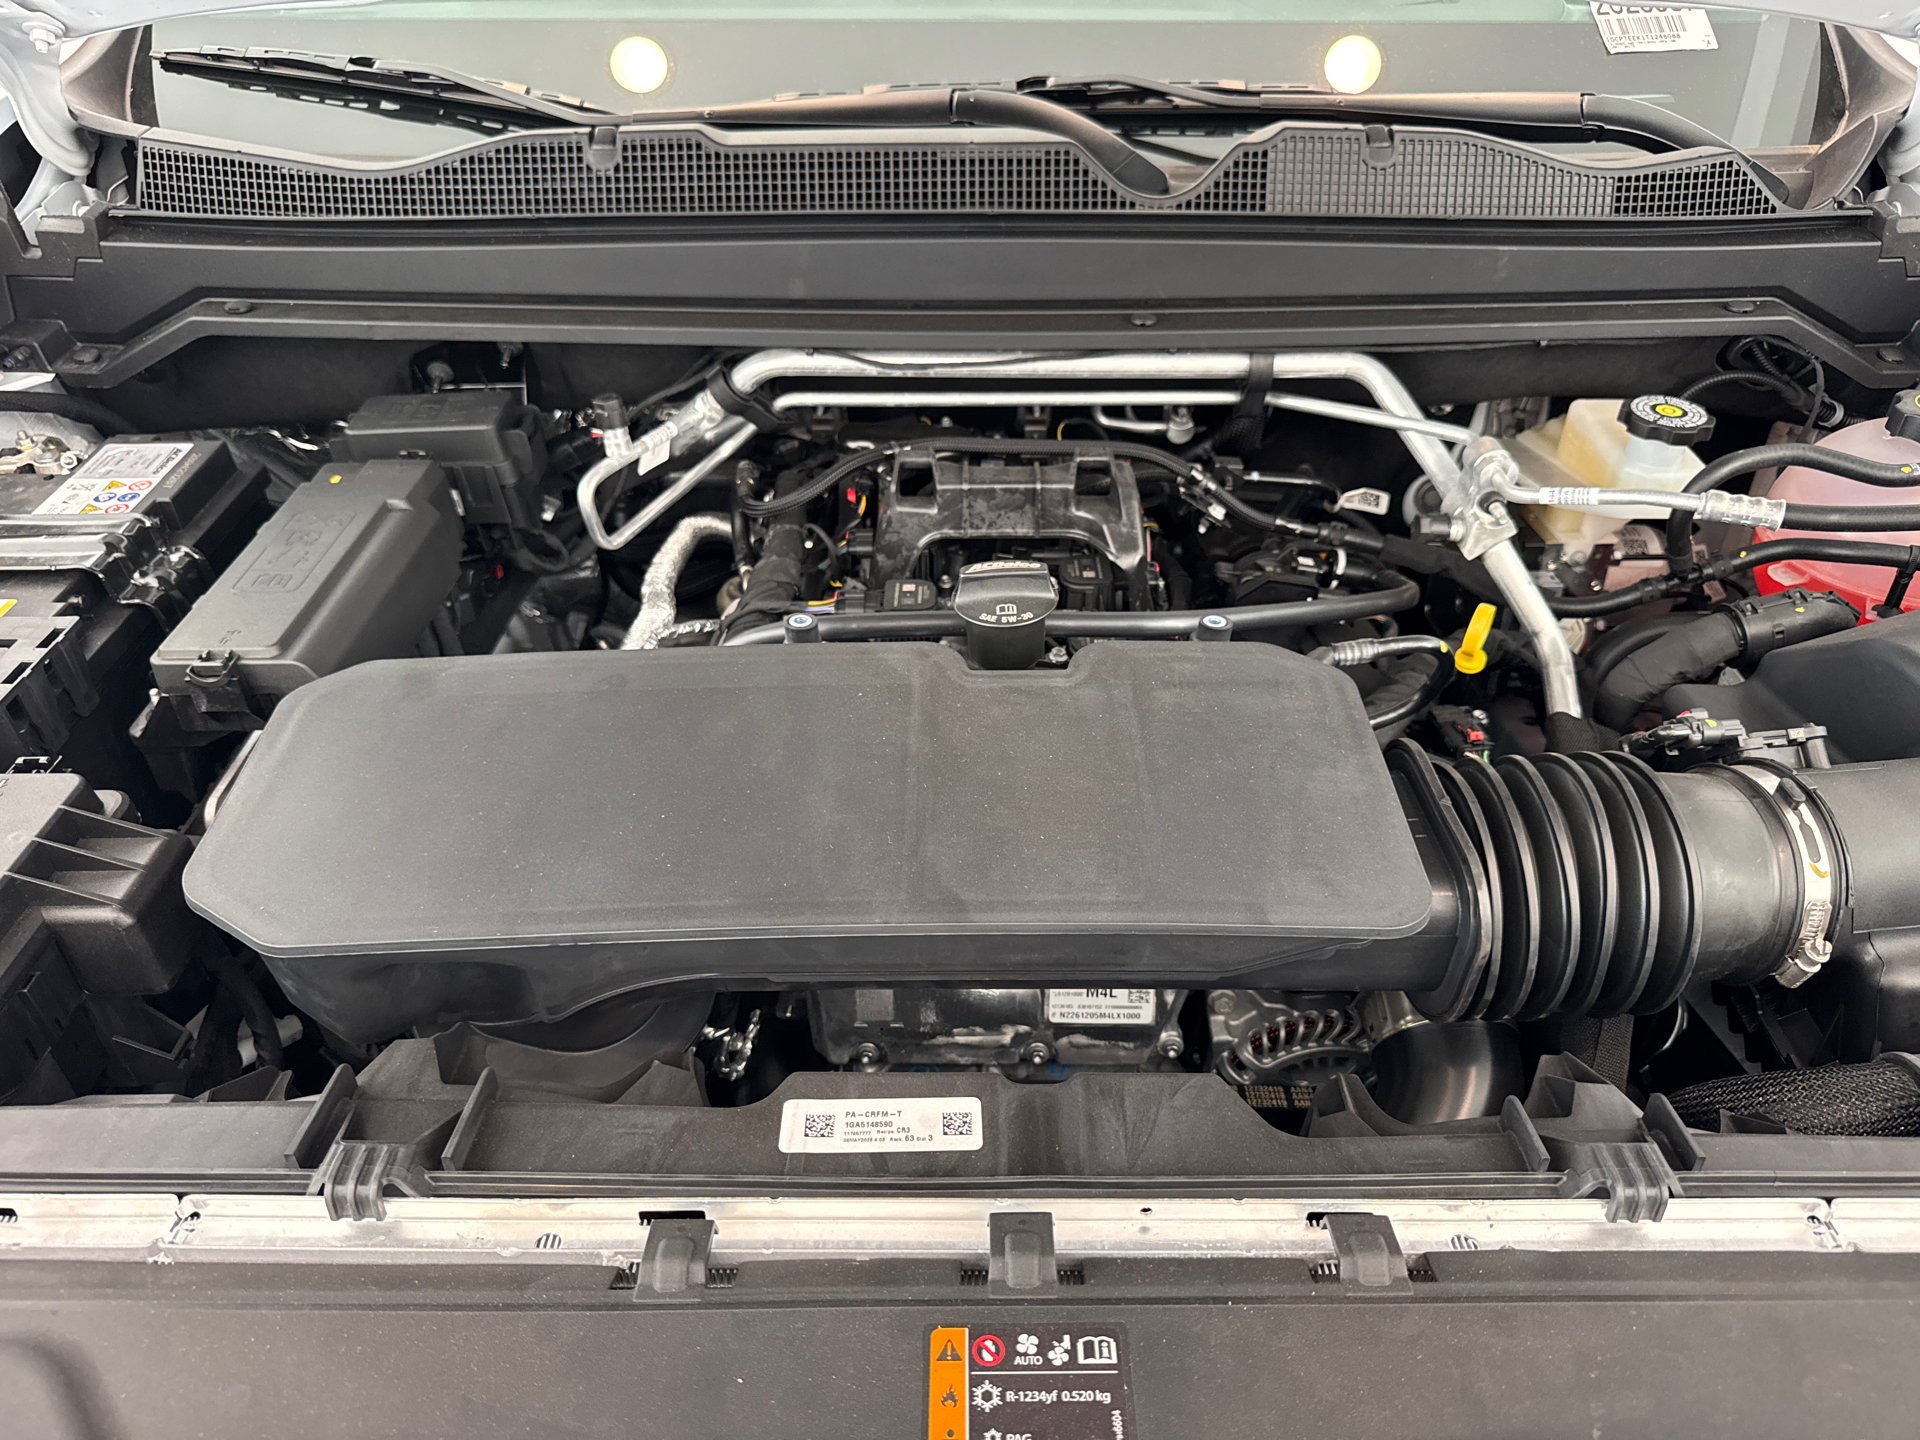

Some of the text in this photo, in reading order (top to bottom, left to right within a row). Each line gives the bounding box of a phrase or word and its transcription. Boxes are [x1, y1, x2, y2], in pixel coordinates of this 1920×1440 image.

[979, 612, 1034, 623] SAE 5W-30
[1086, 989, 1118, 998] M4L
[905, 1134, 915, 1142] 63
[928, 1134, 934, 1142] 3
[1014, 1355, 1043, 1366] AUTO
[1005, 1389, 1112, 1404] R-1234yf 0.520 kg
